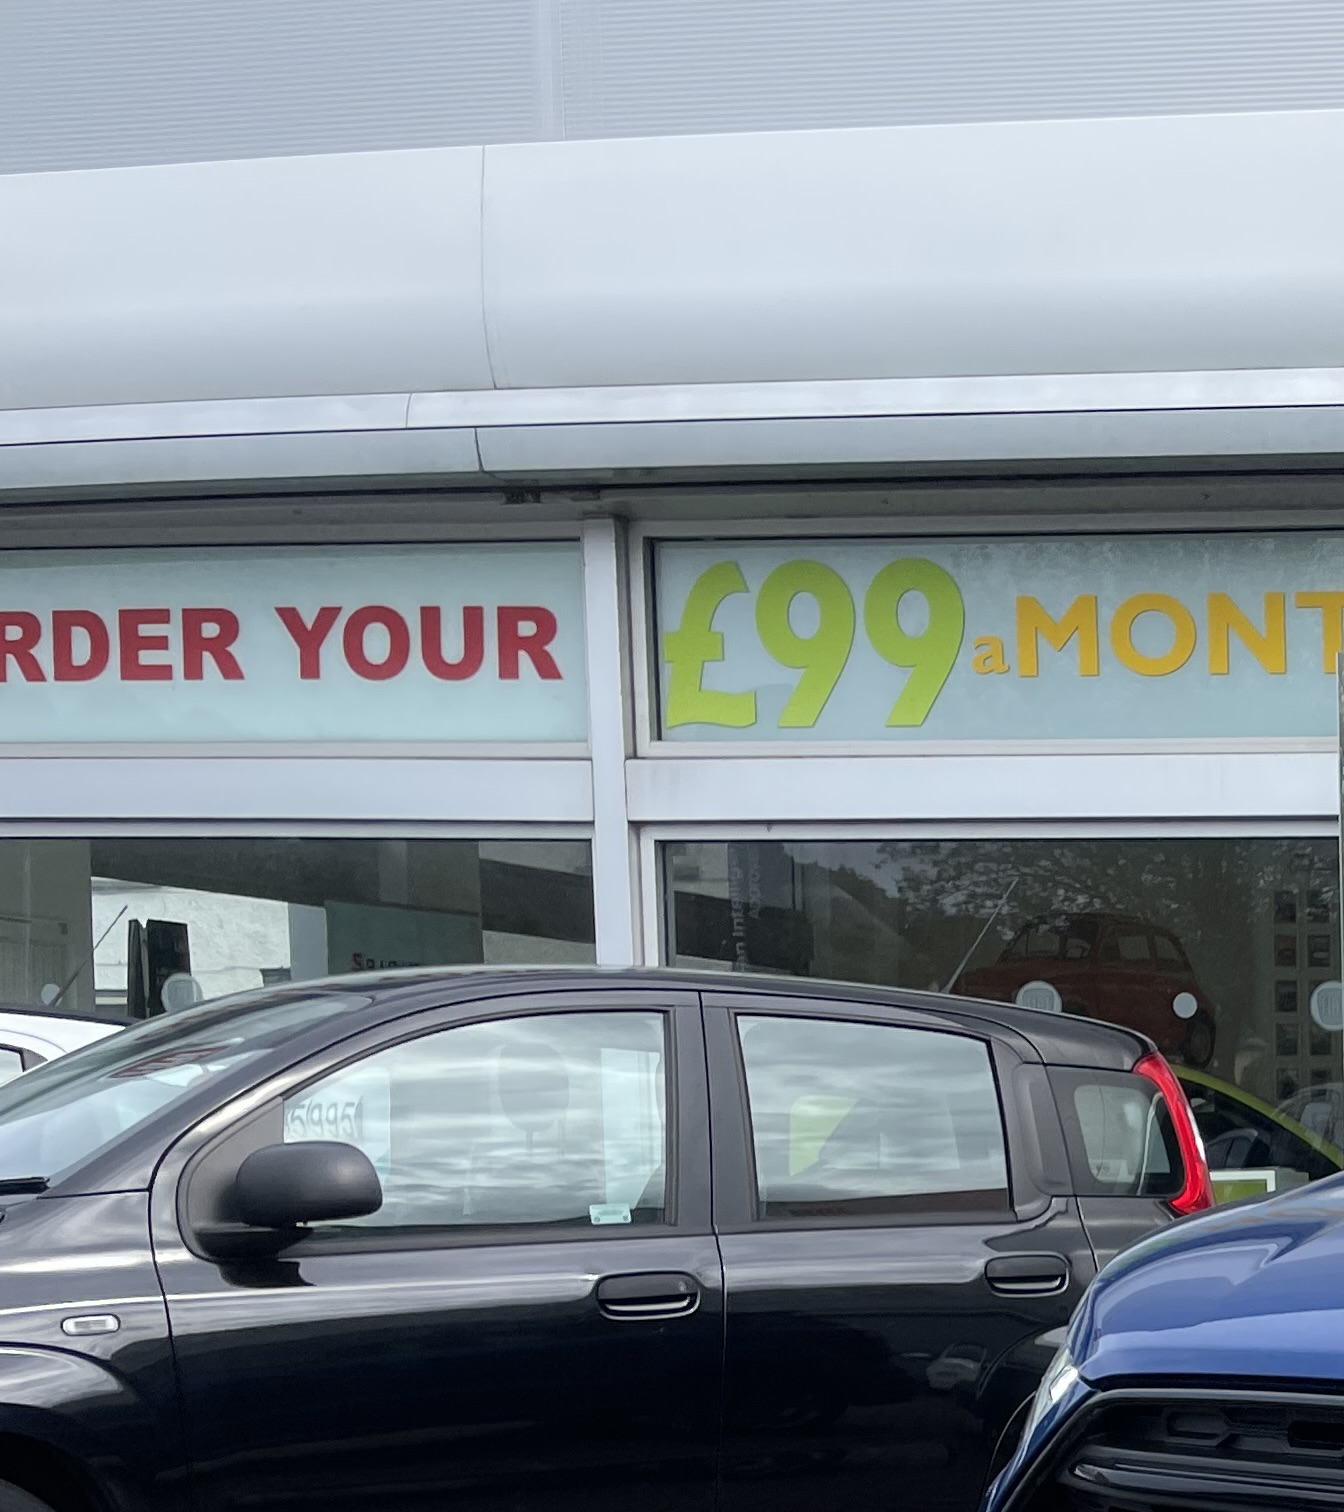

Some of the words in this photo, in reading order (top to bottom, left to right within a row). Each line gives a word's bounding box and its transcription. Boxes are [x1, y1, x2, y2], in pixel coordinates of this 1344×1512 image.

[0, 607, 246, 683] RDER
[274, 605, 564, 682] YOUR
[663, 558, 966, 729] £99
[971, 634, 1009, 676] a
